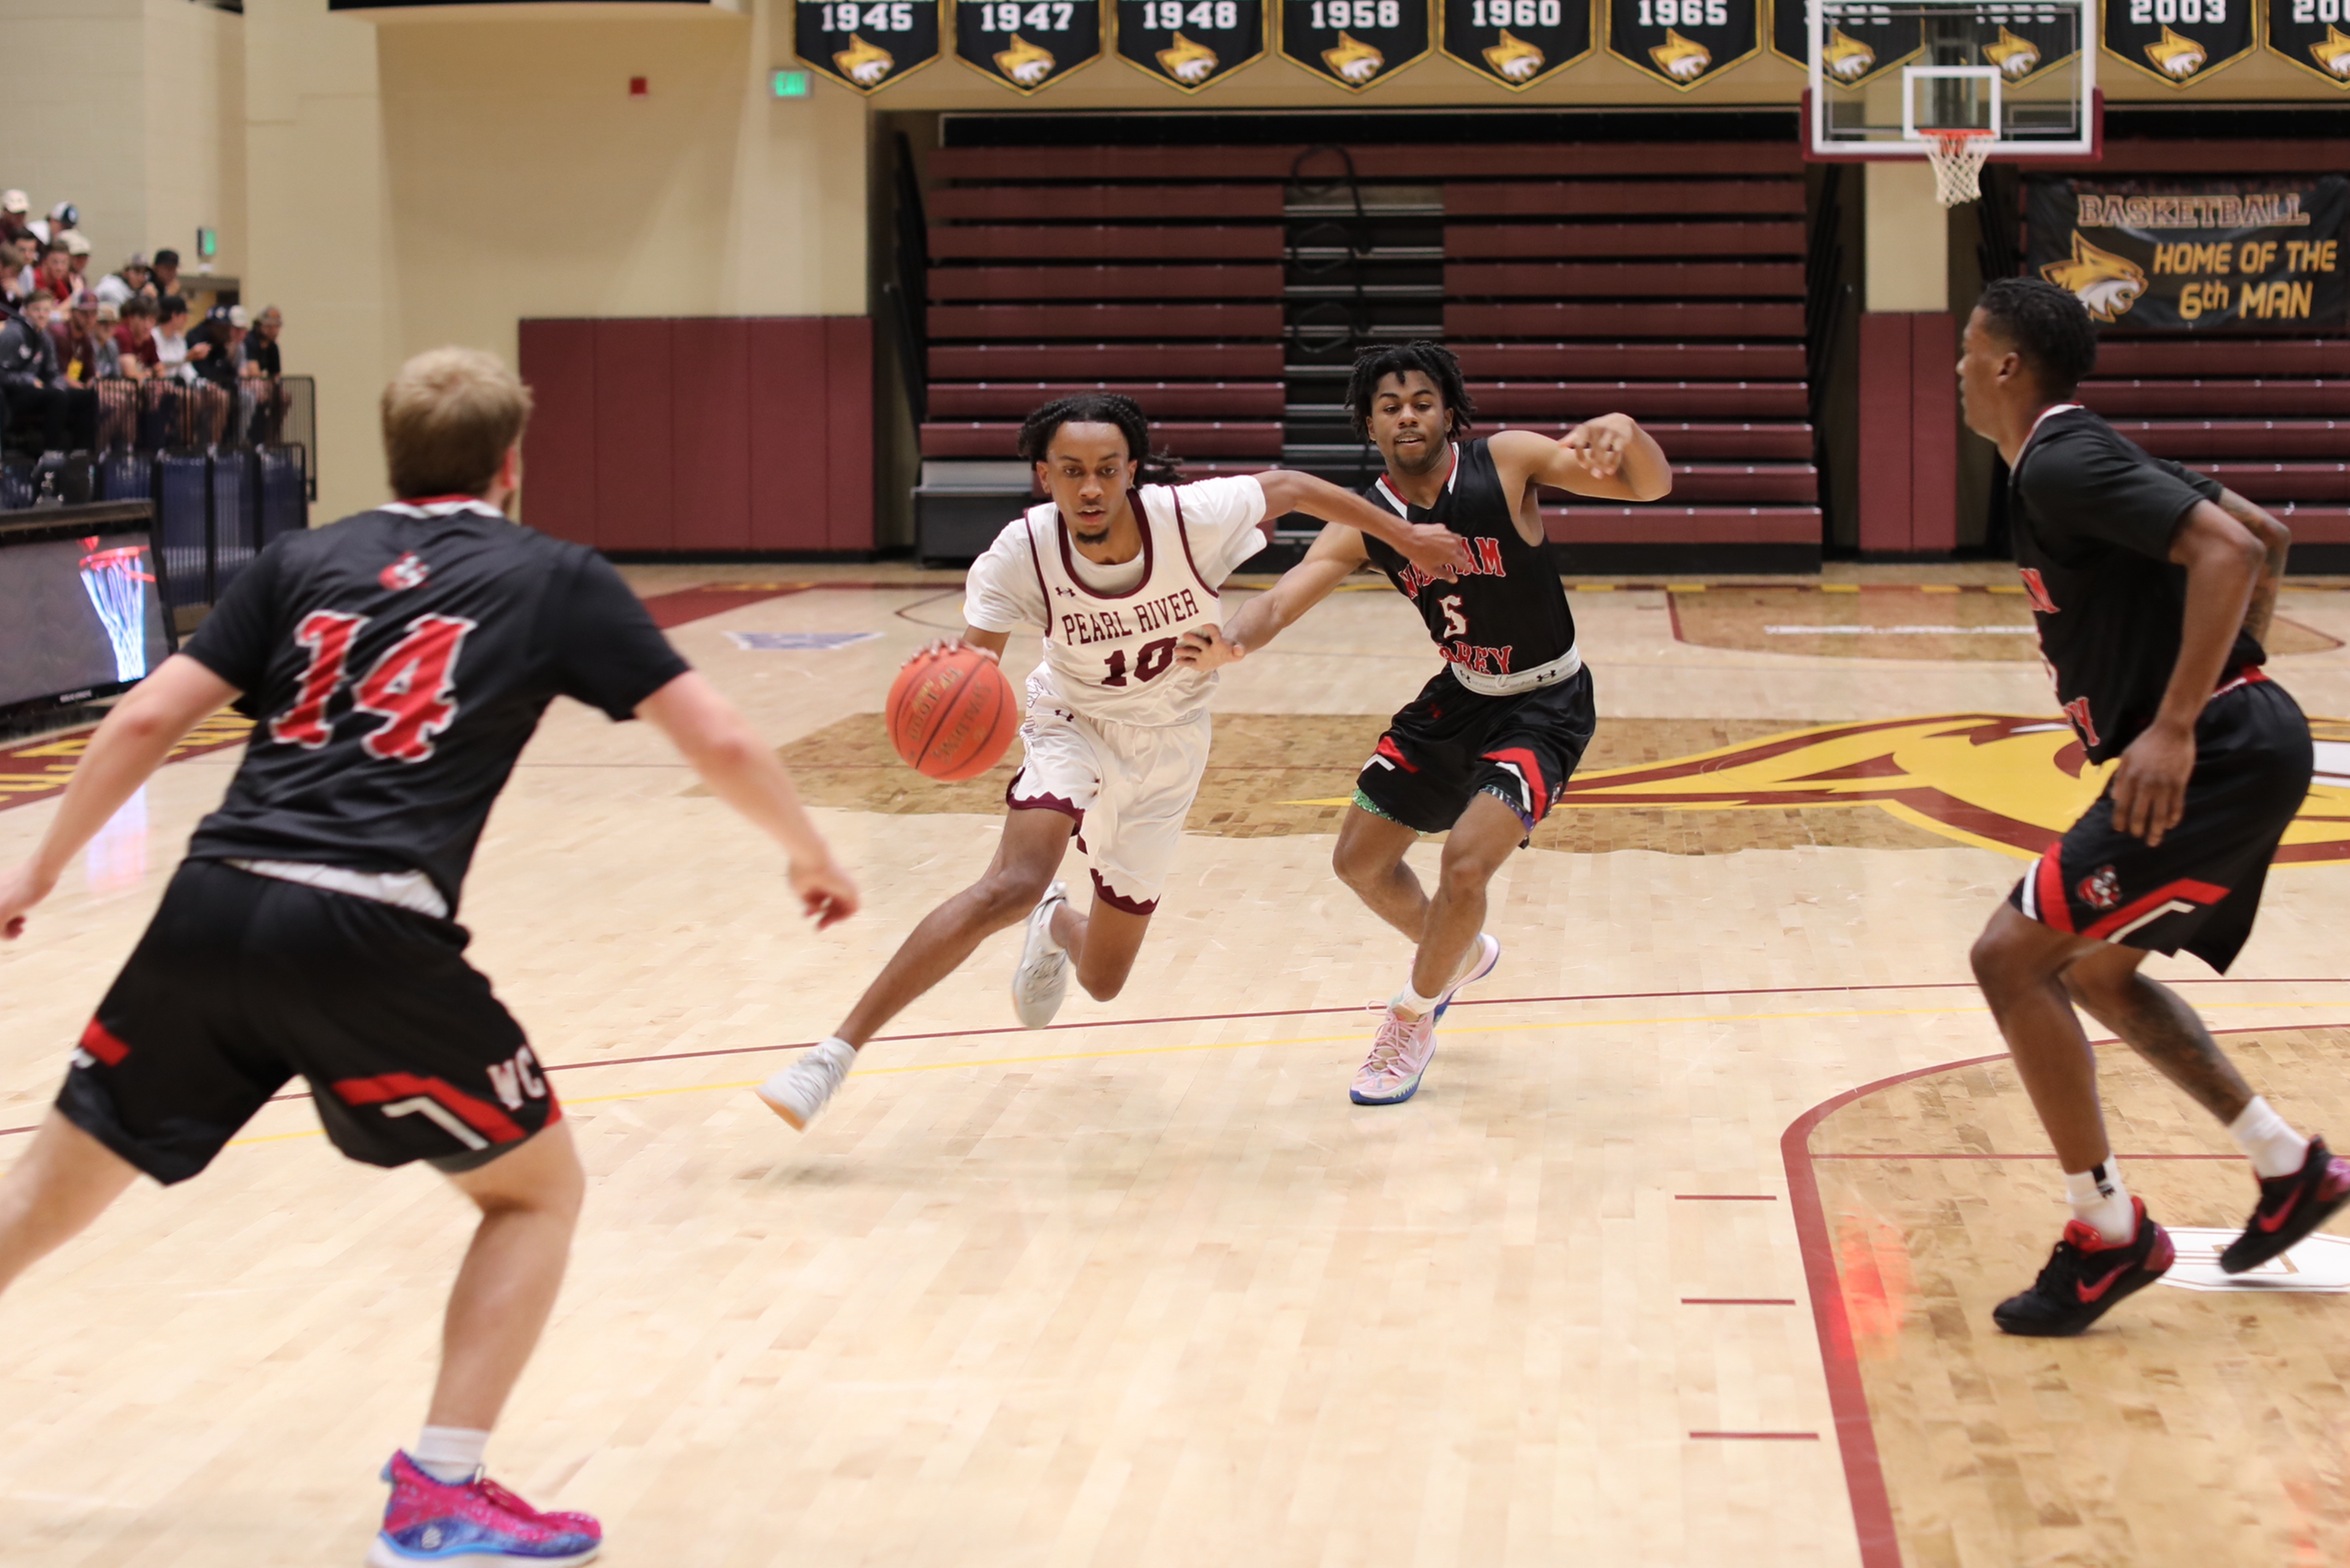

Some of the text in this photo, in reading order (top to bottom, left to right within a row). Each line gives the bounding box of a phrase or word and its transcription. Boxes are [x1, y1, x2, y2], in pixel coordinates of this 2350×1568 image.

[821, 3, 913, 31] 1945
[981, 3, 1073, 31] 1947
[1144, 1, 1237, 29] 1948
[1311, 1, 1399, 28] 1958
[1472, 0, 1561, 27] 1960
[1638, 0, 1727, 26] 1965
[2130, 0, 2226, 24] 2003
[2077, 194, 2310, 228] BASKETBALL
[2153, 240, 2338, 275] HOME OF THE
[2178, 280, 2313, 320] 6th MAN
[1061, 588, 1200, 646] PEARL RIVER
[1439, 594, 1469, 639] 5
[1101, 636, 1178, 687] 10
[268, 608, 479, 764] 14
[485, 1044, 547, 1112] WC
